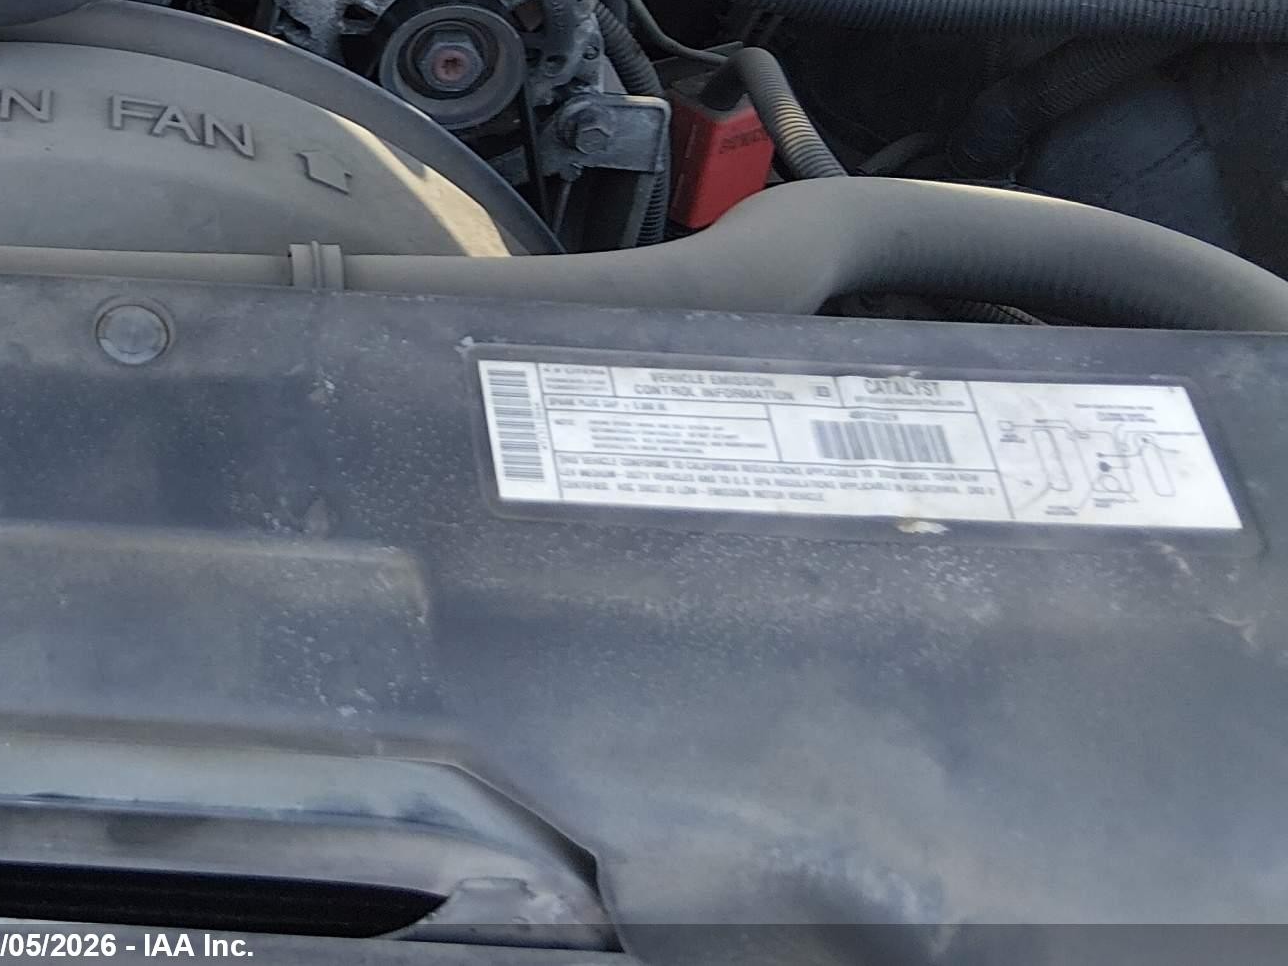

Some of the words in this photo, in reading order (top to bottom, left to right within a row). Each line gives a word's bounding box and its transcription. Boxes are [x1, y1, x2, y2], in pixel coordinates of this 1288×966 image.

[108, 94, 256, 158] FAN
[649, 372, 706, 385] VEHICLE
[711, 375, 776, 387] EMISSION
[864, 378, 941, 396] CATALYST
[633, 383, 696, 397] CONTROL
[701, 386, 795, 401] INFORMATION
